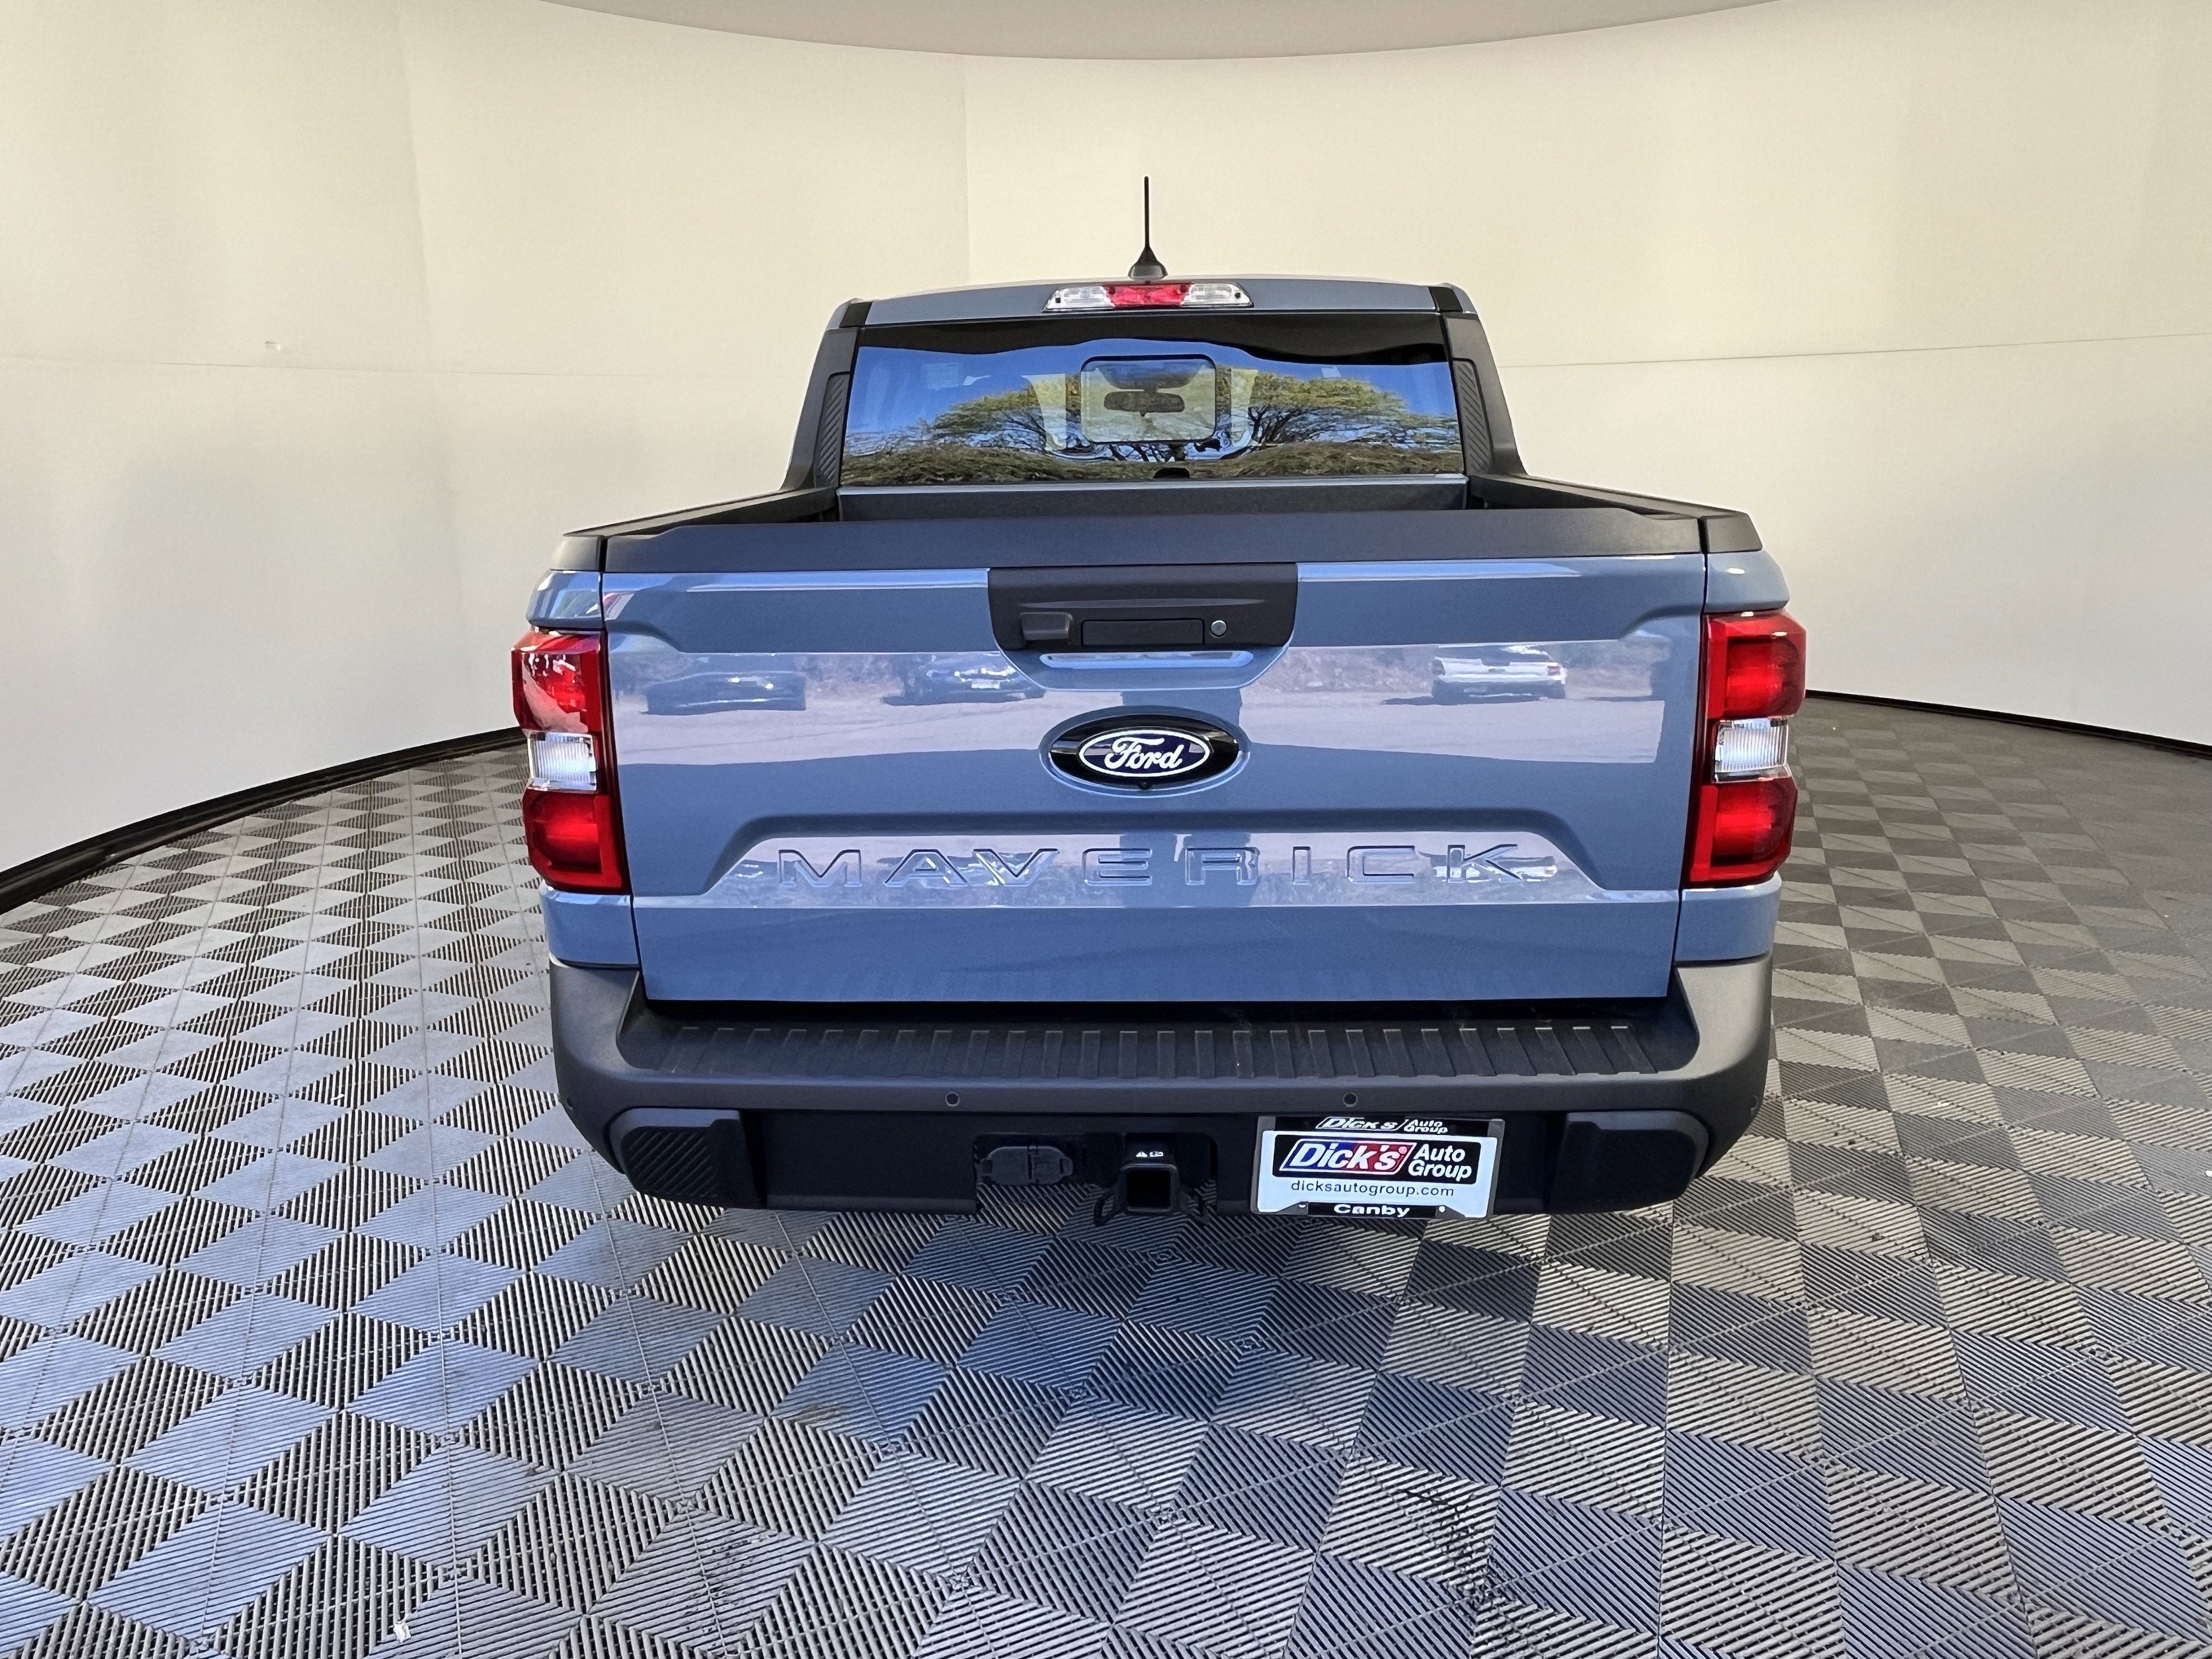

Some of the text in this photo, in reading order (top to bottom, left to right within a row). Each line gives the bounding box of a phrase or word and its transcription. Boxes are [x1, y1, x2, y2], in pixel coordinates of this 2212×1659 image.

[1104, 737, 1183, 769] Ford
[778, 844, 1523, 888] MAVERICK
[1322, 1117, 1398, 1130] Dicks
[1403, 1125, 1448, 1134] Group
[1289, 1143, 1398, 1170] Dick's
[1417, 1144, 1465, 1162] Auto
[1408, 1160, 1472, 1181] Group
[1291, 1180, 1454, 1197] dicksautogroup.com
[1334, 1204, 1410, 1218] Canby
